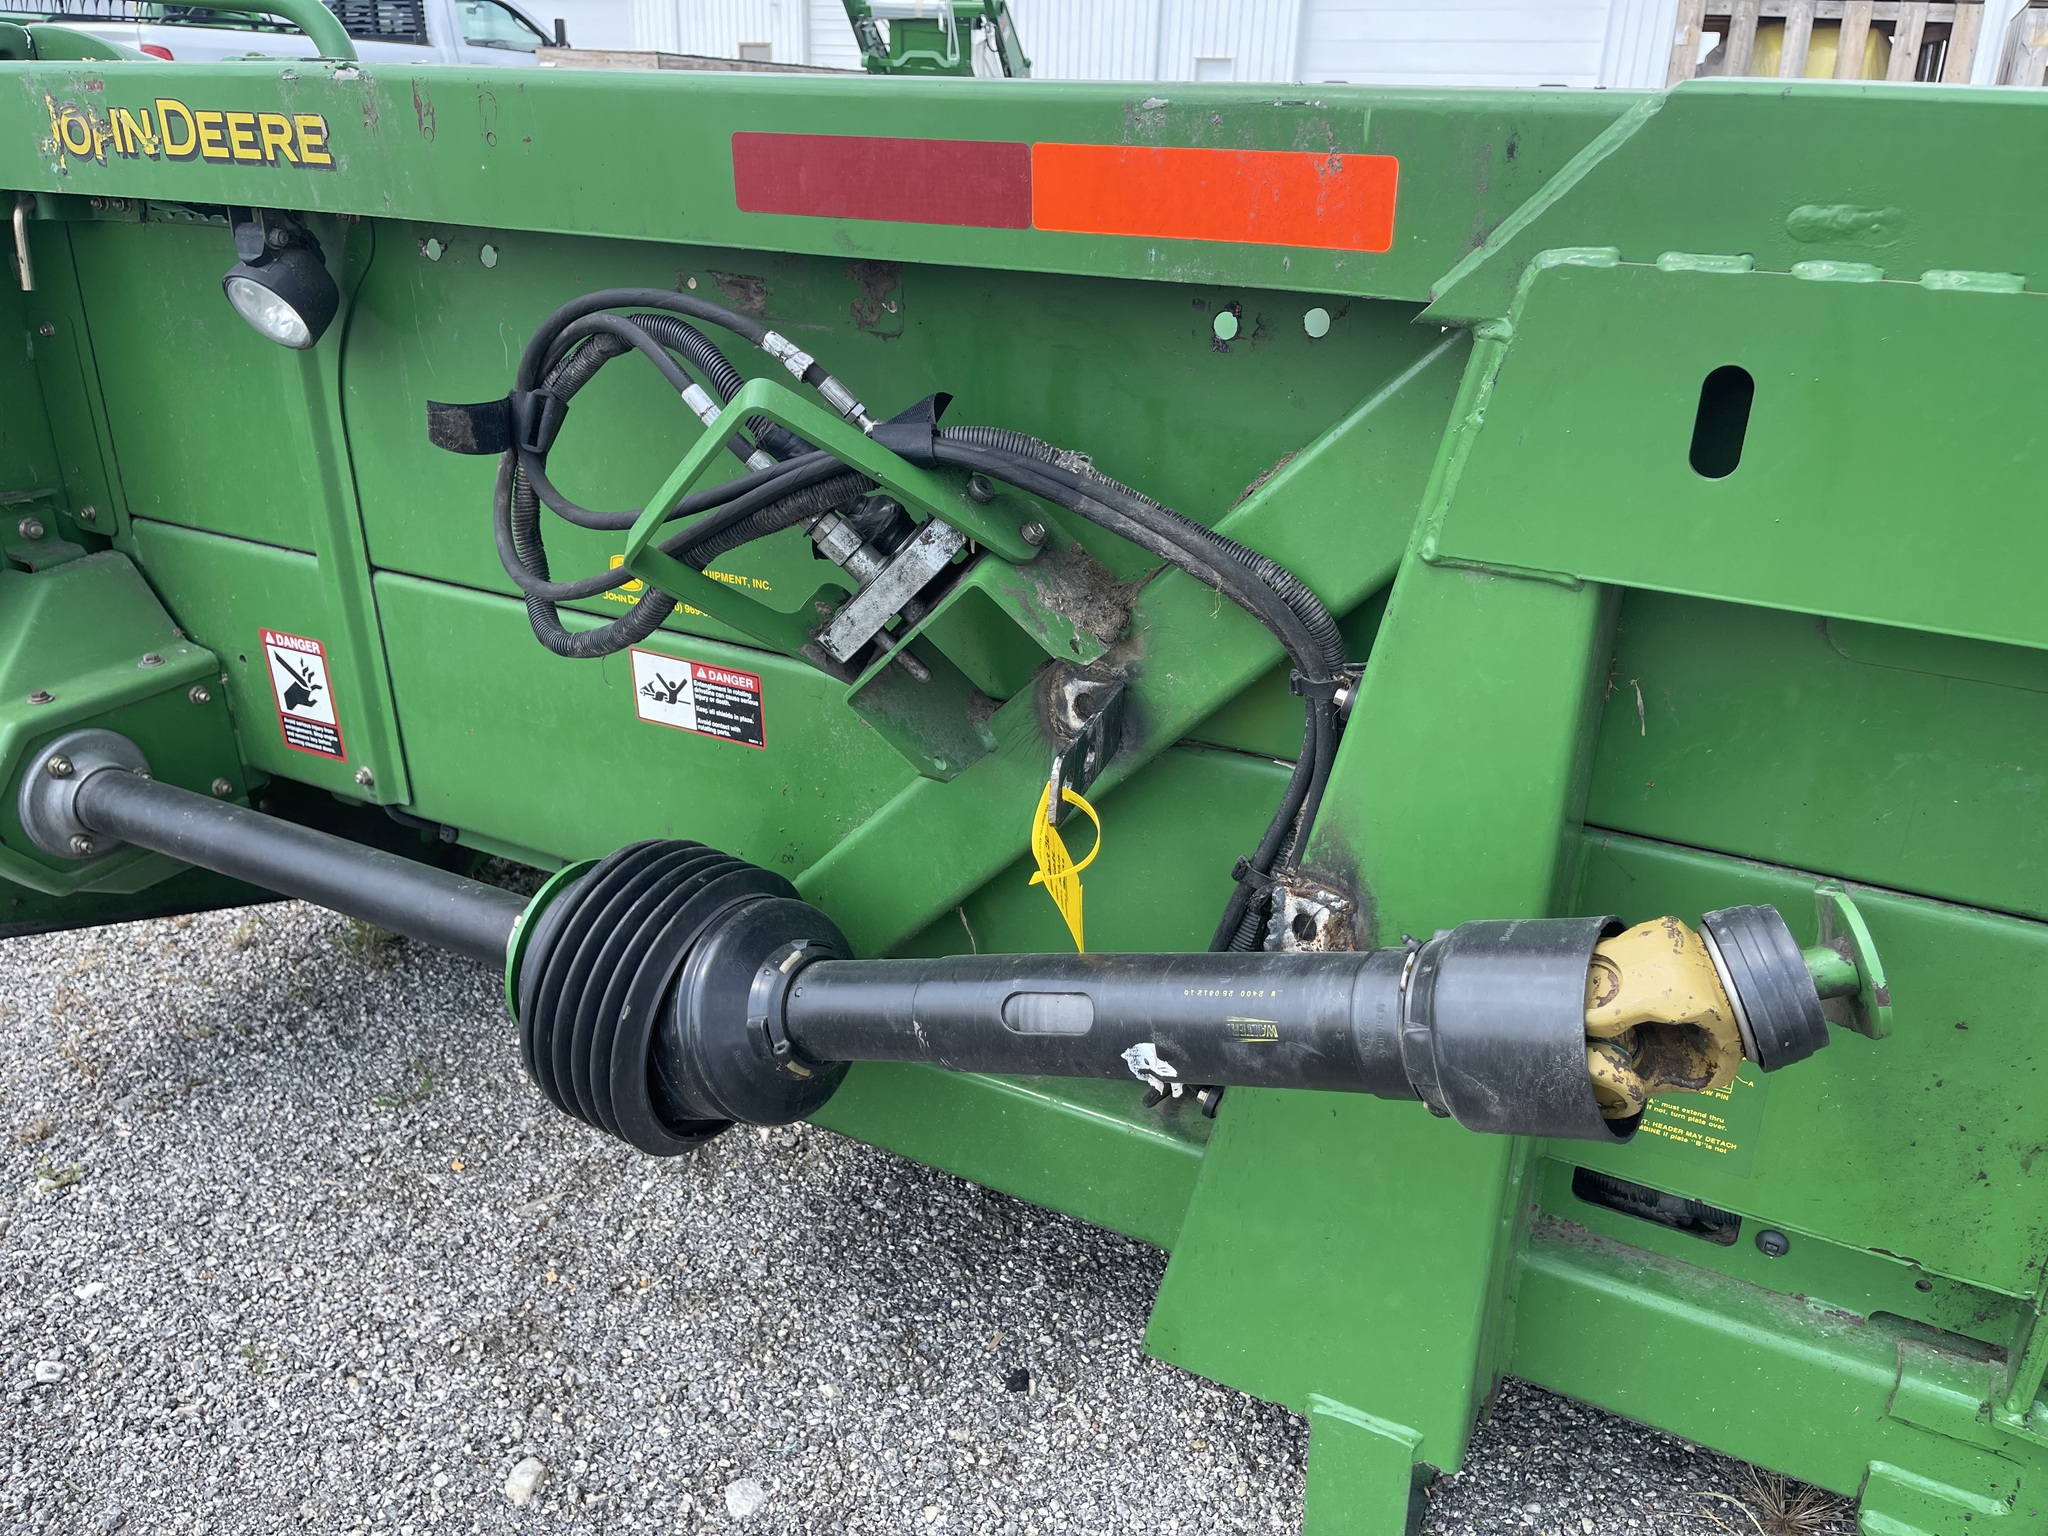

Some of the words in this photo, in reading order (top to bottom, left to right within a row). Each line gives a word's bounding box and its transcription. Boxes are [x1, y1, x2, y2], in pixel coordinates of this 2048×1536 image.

[43, 92, 160, 173] JOHN
[155, 98, 336, 171] DEERE
[752, 578, 773, 591] INC.
[603, 591, 627, 603] JOHN
[276, 634, 320, 654] DANGER
[708, 670, 753, 689] DANGER
[694, 680, 726, 693] Entanglement
[733, 690, 752, 699] rotating
[726, 694, 740, 702] cause
[741, 698, 758, 706] serious
[696, 705, 708, 714] Keep
[716, 710, 734, 719] shields
[698, 718, 711, 726] Avoid
[712, 721, 730, 730] contact
[698, 724, 716, 734] rotating
[1715, 1092, 1730, 1100] PIN
[1654, 1106, 1668, 1115] not,
[1671, 1111, 1686, 1119] turn
[1688, 1116, 1706, 1125] plate
[1708, 1122, 1727, 1131] over.
[1662, 1102, 1680, 1111] must
[1682, 1107, 1707, 1118] extend
[1709, 1114, 1724, 1124] thru
[1652, 1122, 1684, 1134] HEADER
[1686, 1130, 1703, 1140] MAY
[1705, 1136, 1737, 1150] DETACH
[1670, 1135, 1689, 1143] plate
[1714, 1145, 1727, 1154] not
